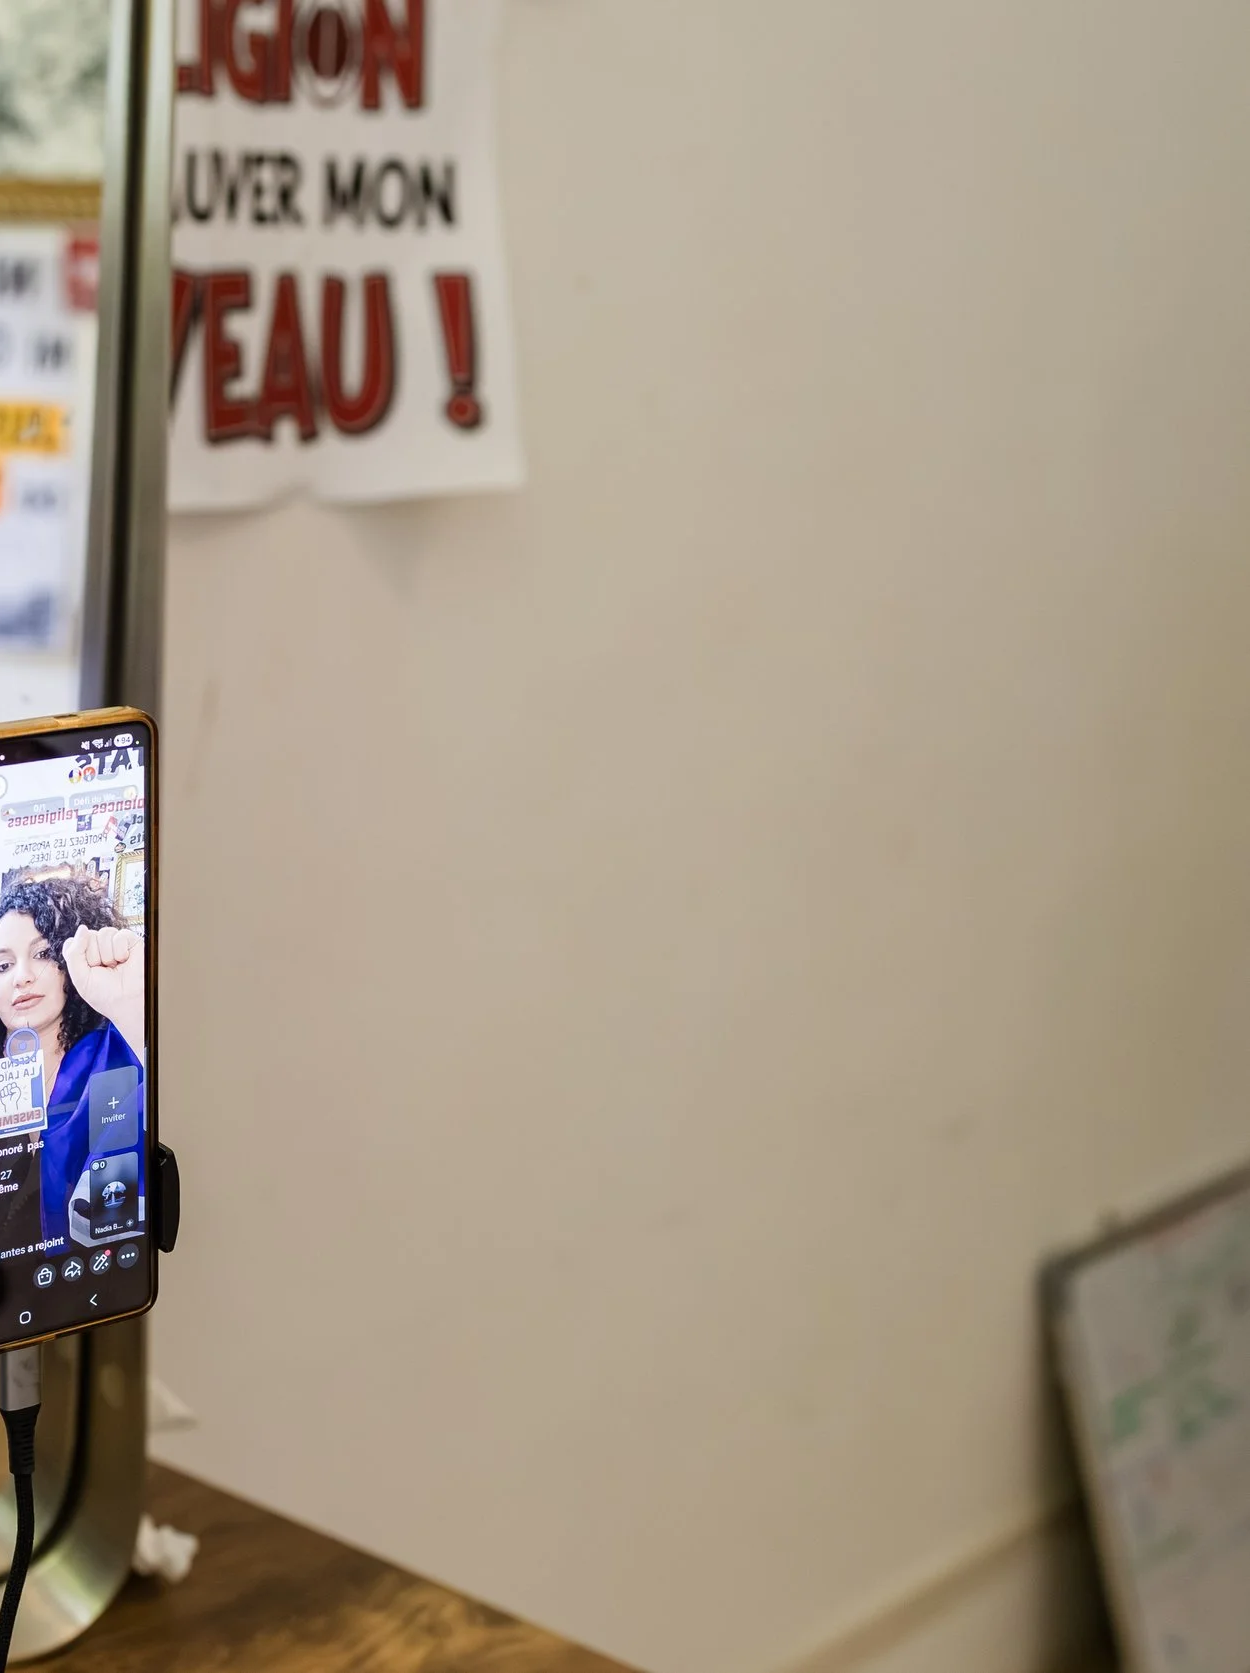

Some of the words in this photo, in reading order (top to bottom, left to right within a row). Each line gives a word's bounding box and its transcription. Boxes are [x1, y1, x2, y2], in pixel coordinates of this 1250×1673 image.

[174, 148, 305, 228] UVER
[321, 156, 457, 230] MON
[101, 1112, 126, 1124] Inviter
[27, 1140, 45, 1153] pas
[0, 1169, 13, 1180] 27
[94, 1224, 112, 1235] Nadia
[27, 1244, 34, 1253] a
[35, 1236, 65, 1252] rejoint
